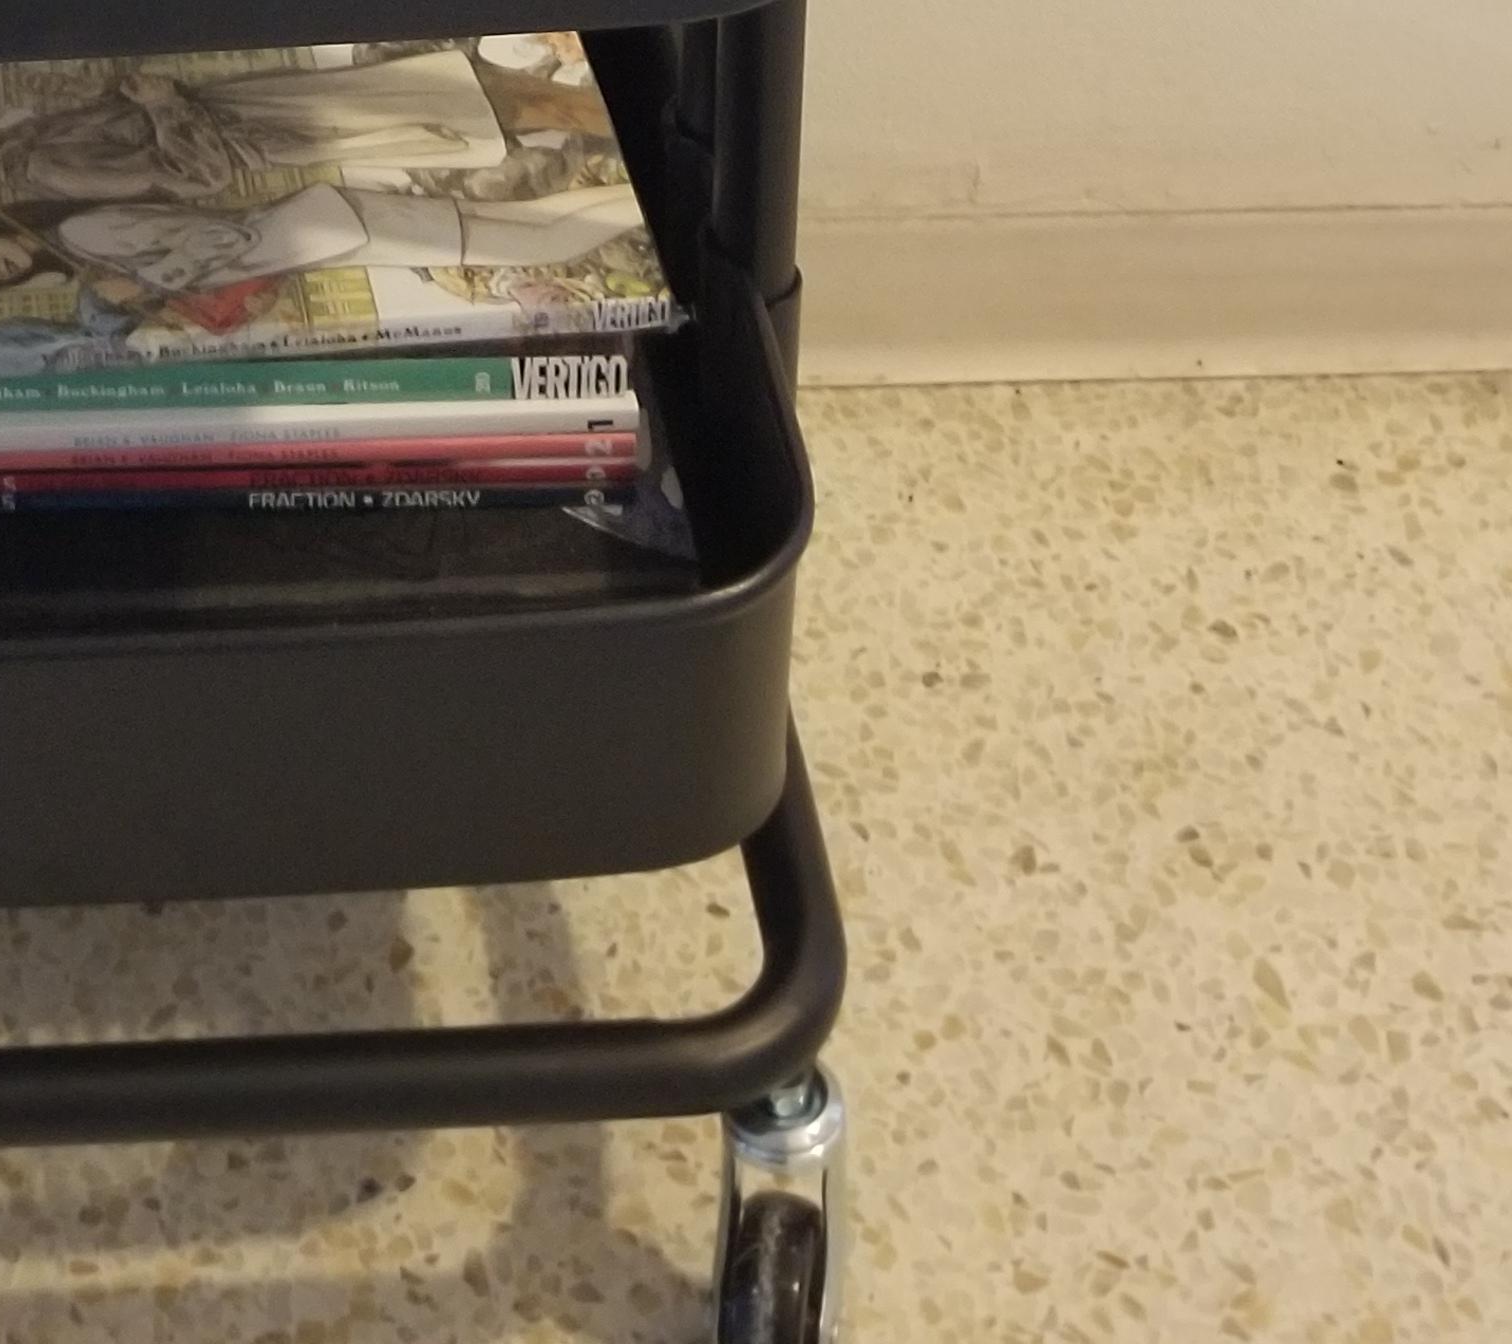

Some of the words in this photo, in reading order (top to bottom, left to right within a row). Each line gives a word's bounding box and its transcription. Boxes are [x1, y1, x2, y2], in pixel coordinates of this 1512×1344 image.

[587, 296, 671, 330] VERTIGO
[375, 322, 462, 342] McManus
[508, 355, 630, 400] VERTIGO
[56, 380, 166, 400] Buckingham
[247, 490, 355, 510] FRACTION
[381, 488, 480, 507] ZDARSKY
